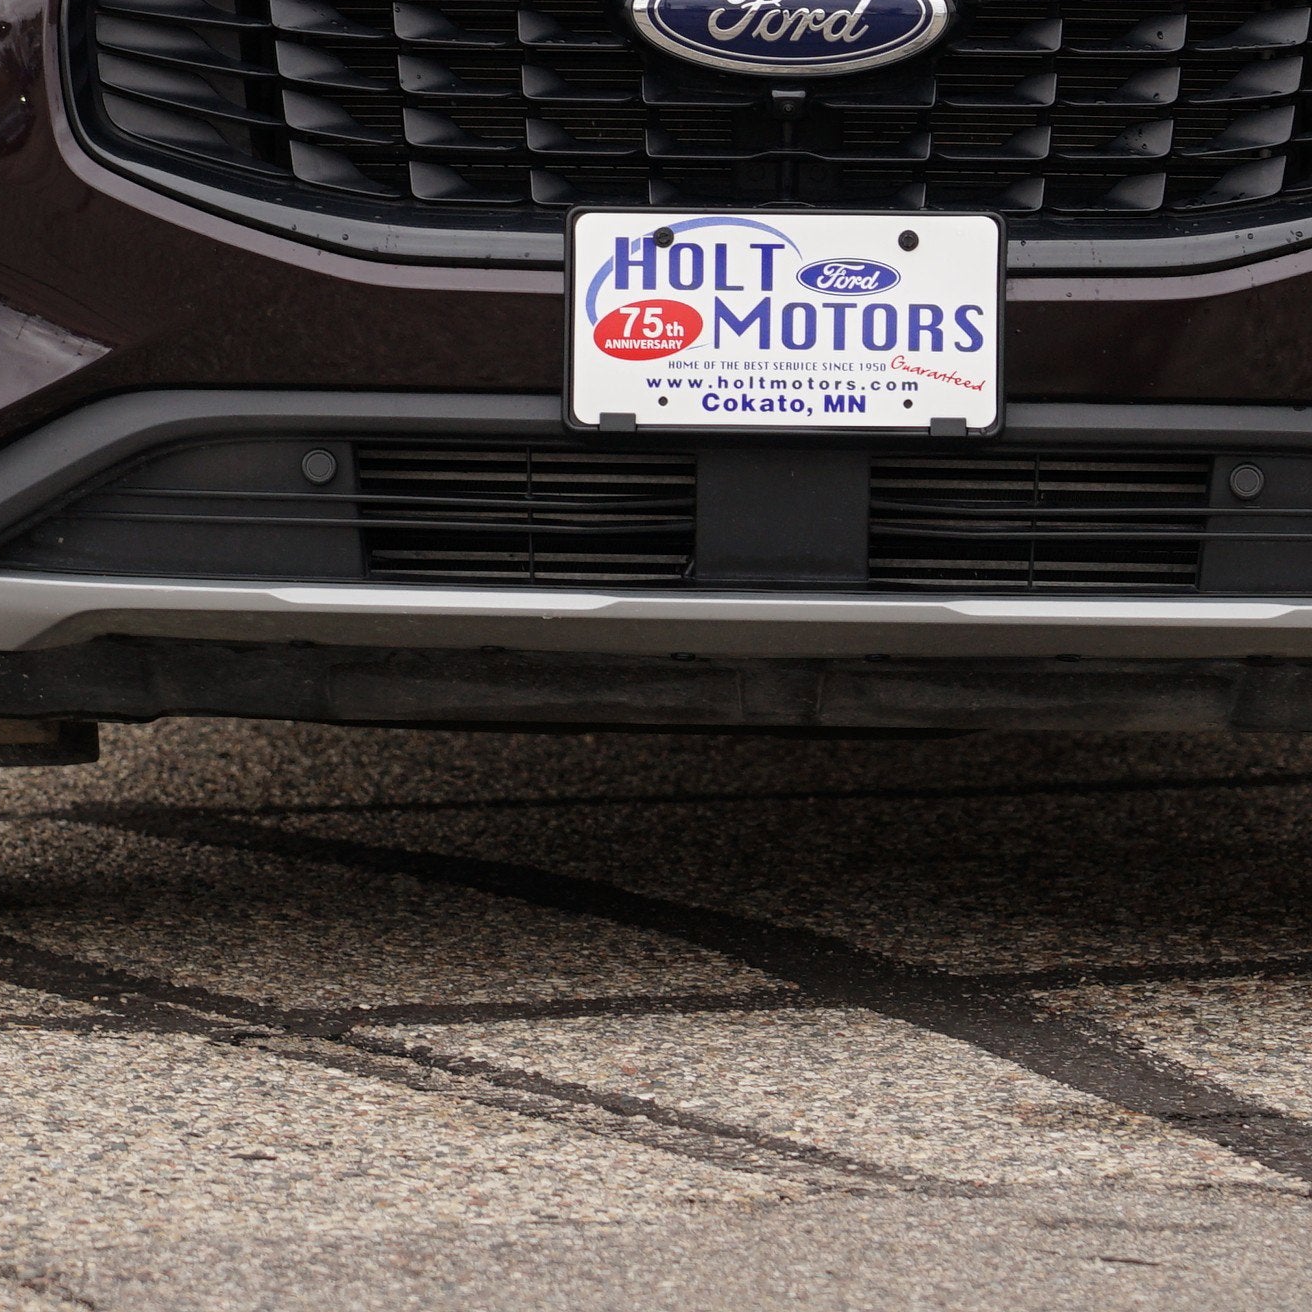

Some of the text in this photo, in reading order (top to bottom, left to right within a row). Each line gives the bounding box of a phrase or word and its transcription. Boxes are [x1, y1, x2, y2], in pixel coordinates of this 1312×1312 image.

[614, 236, 786, 292] HOLT
[816, 261, 882, 291] Ford
[619, 306, 685, 339] 75th
[713, 295, 985, 353] MOTORS
[604, 338, 684, 351] ANNIVERSARY
[668, 360, 887, 373] HOME OF THE BEST SERVICE SINCE 1950
[890, 355, 986, 392] Guaranteed
[646, 376, 919, 392] www.holtmotors.com
[701, 392, 867, 417] Cokato, MN
